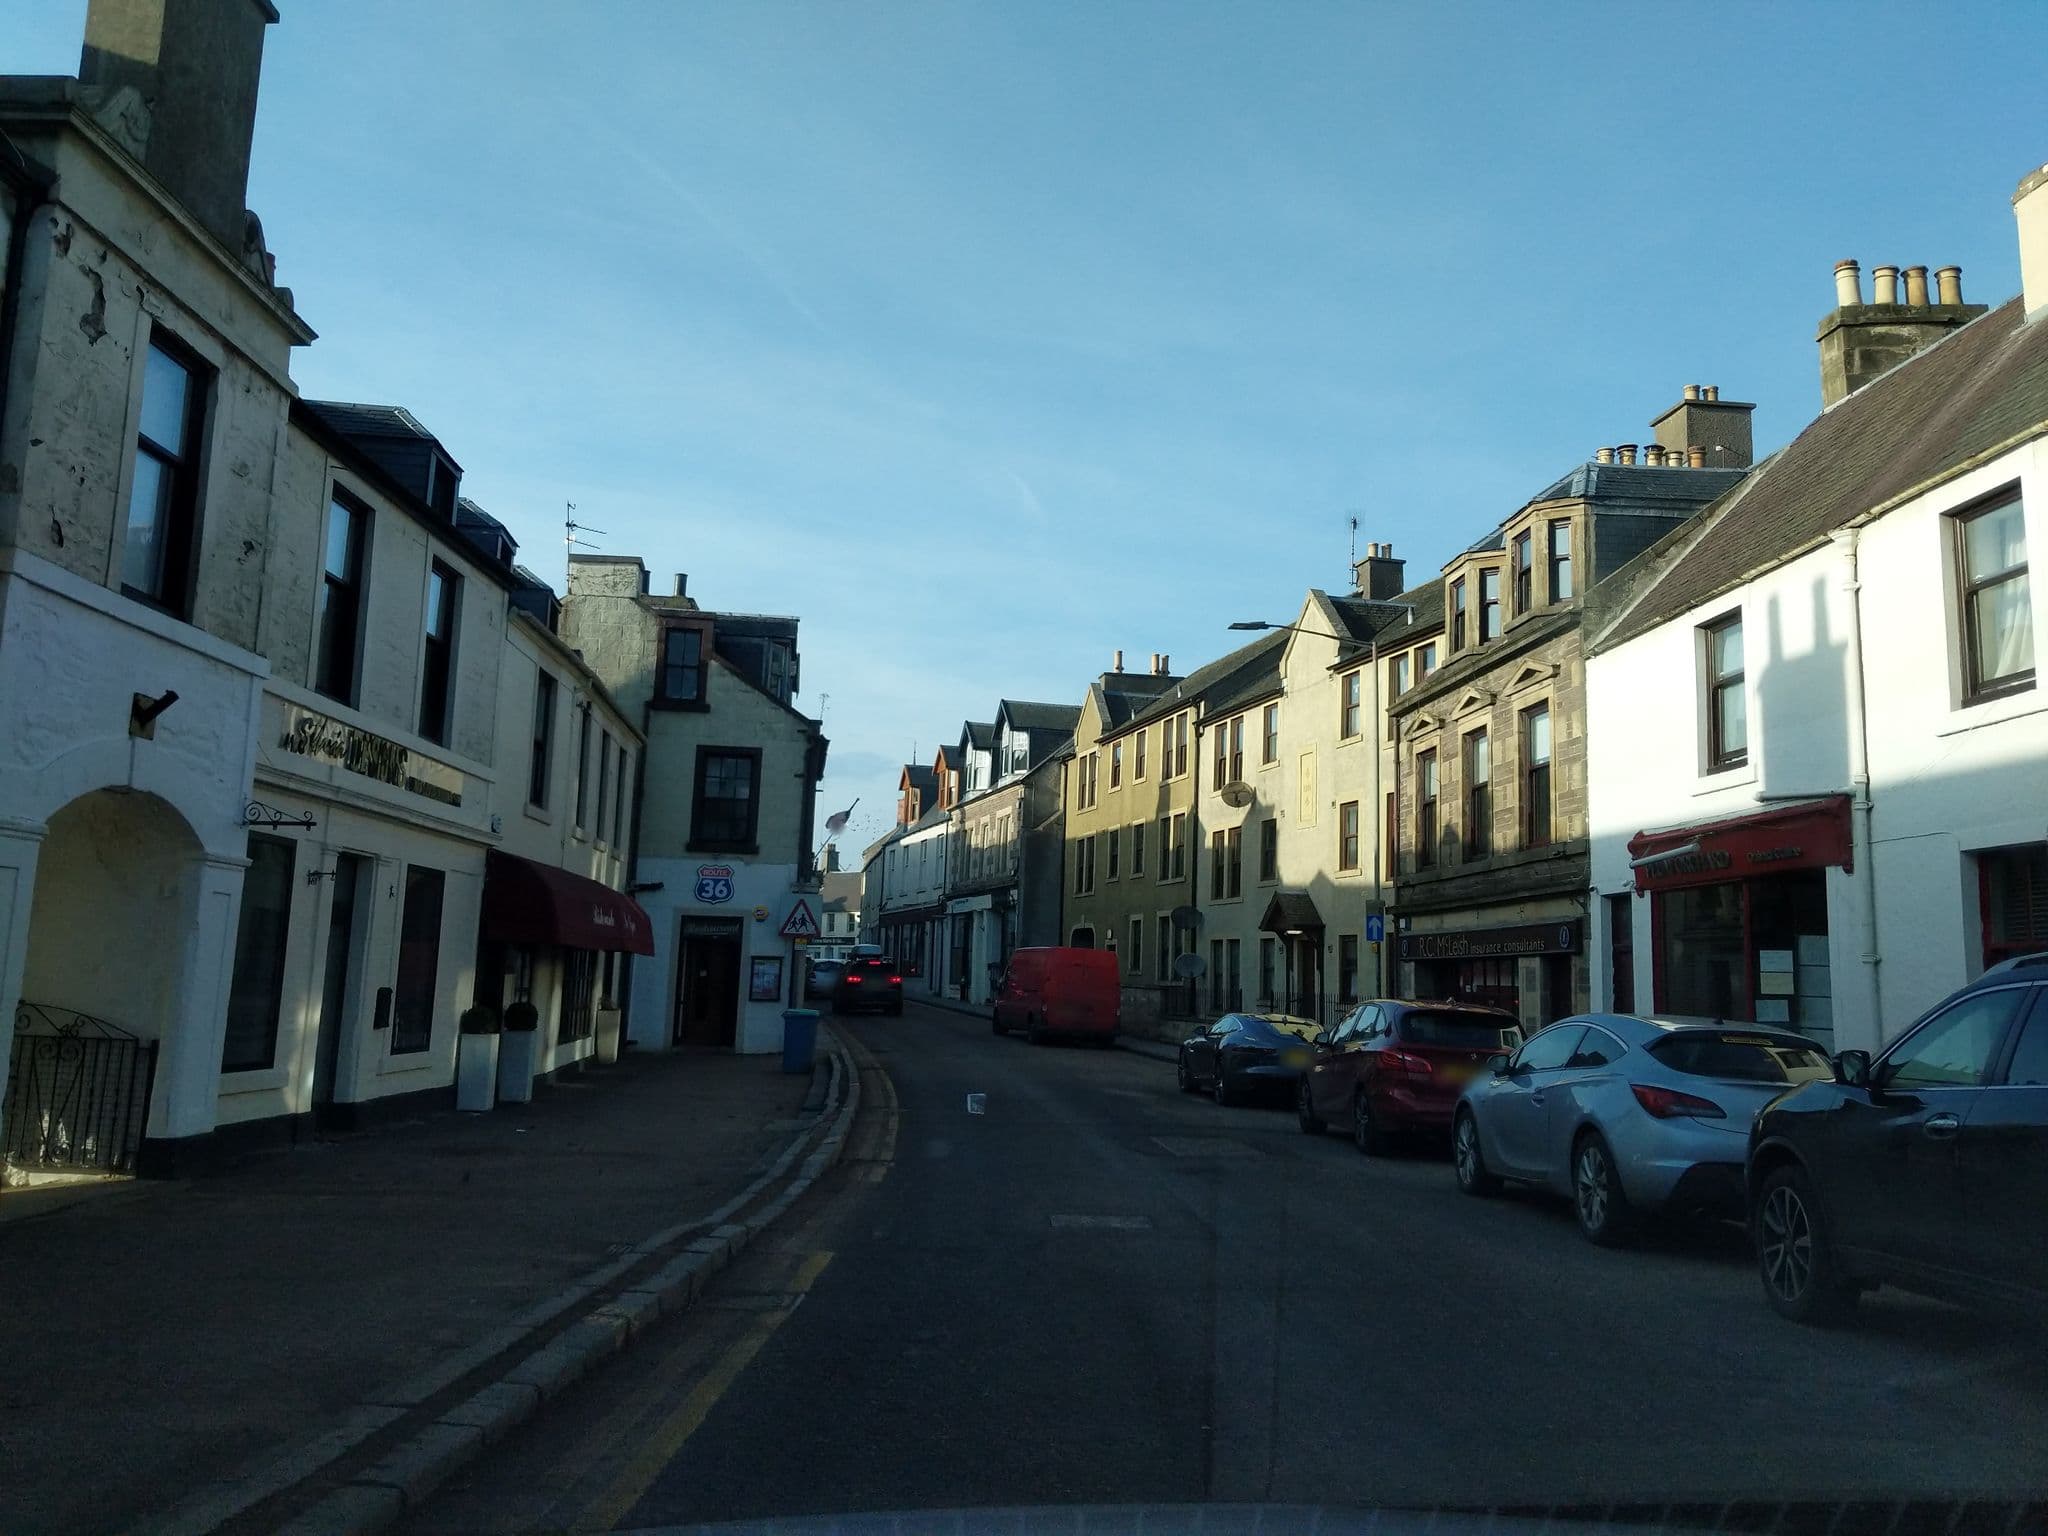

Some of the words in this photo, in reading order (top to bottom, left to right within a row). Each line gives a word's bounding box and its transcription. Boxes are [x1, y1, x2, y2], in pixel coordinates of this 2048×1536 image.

[702, 868, 729, 876] ROUTE
[700, 879, 729, 898] 36
[1471, 942, 1502, 955] insurance
[1504, 938, 1545, 954] consultants
